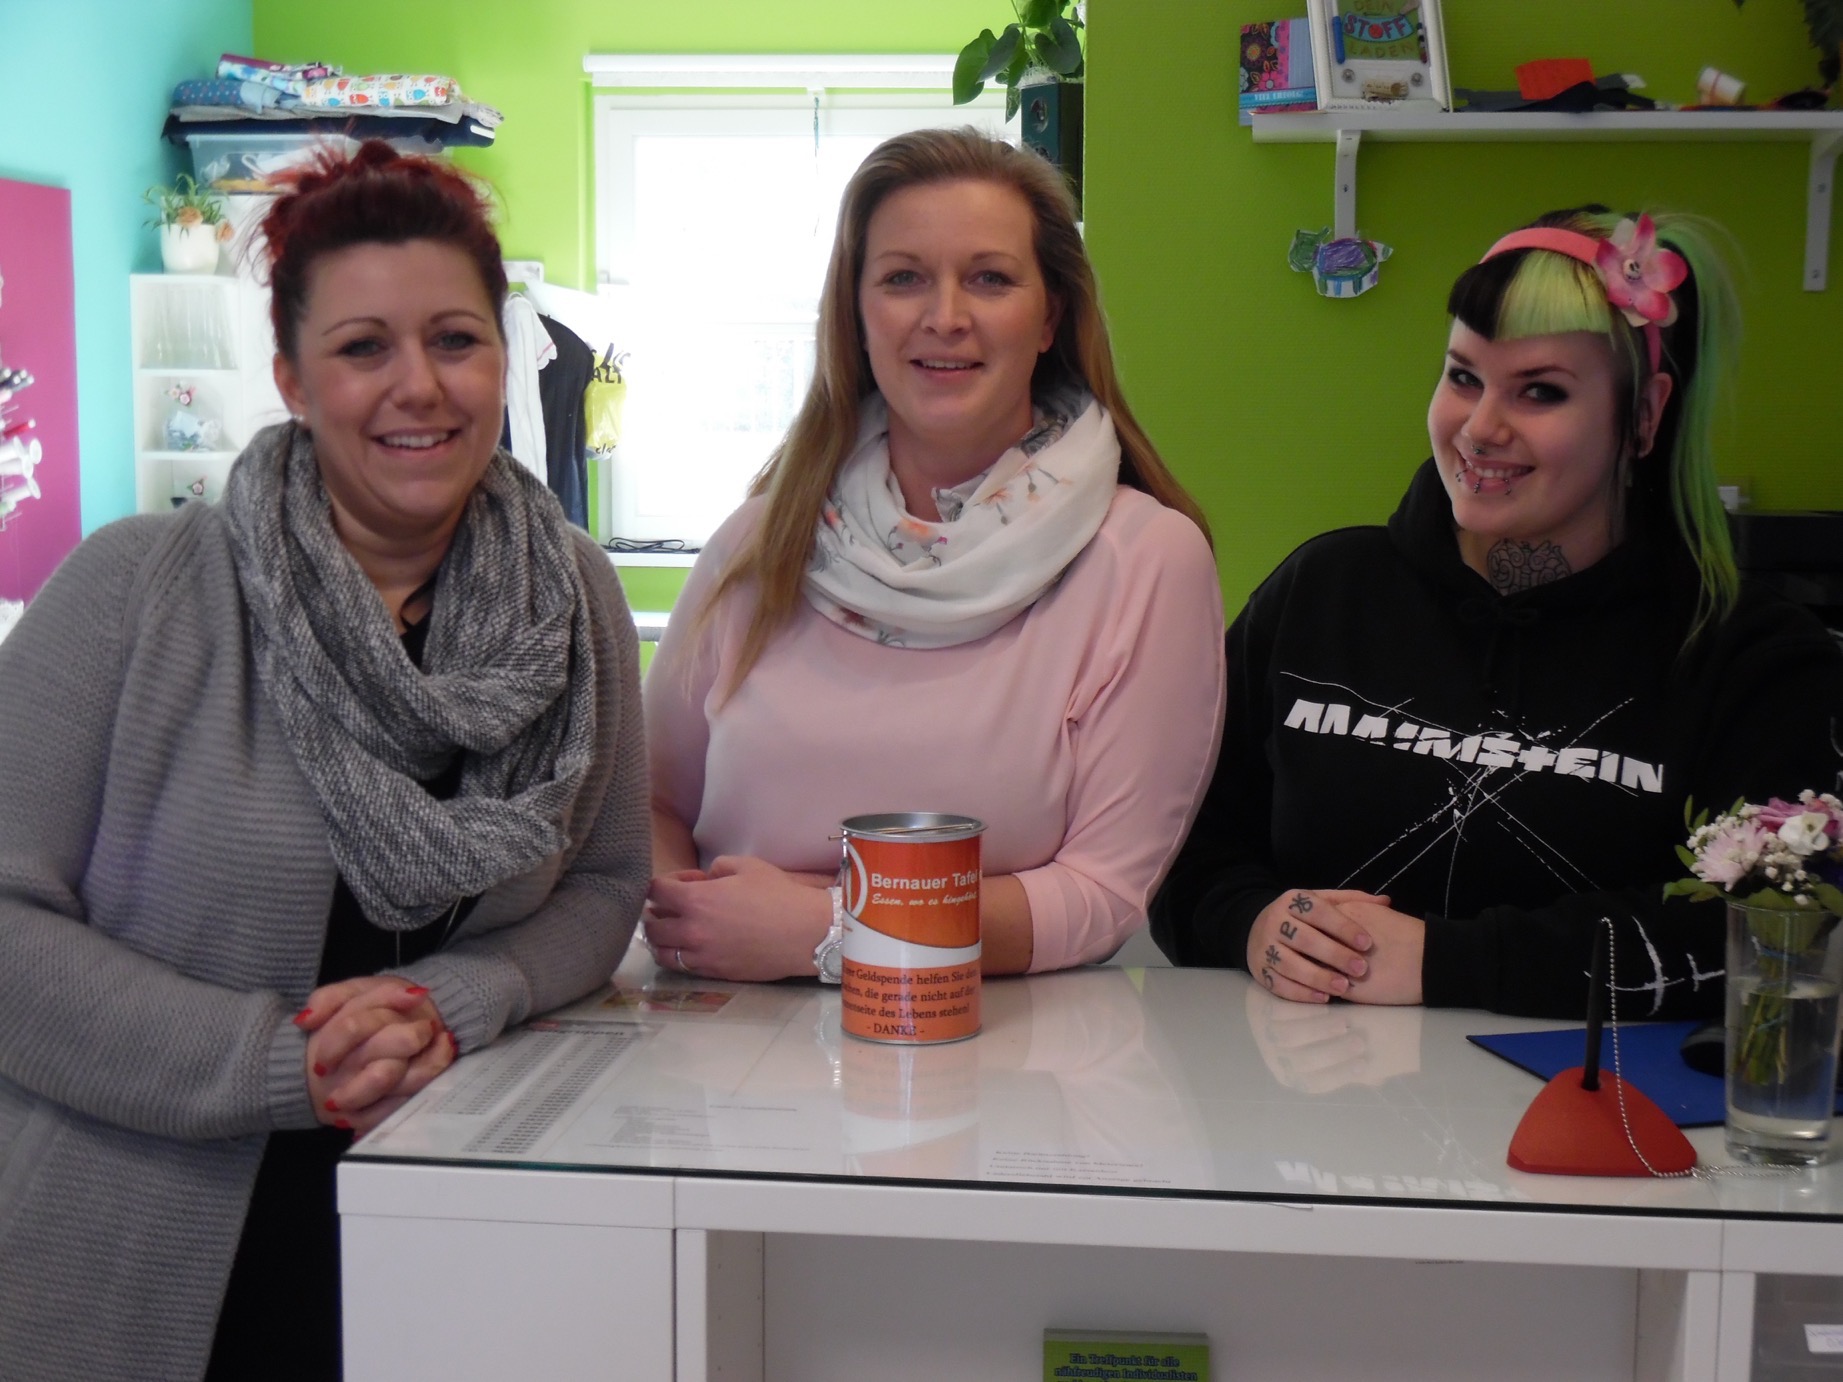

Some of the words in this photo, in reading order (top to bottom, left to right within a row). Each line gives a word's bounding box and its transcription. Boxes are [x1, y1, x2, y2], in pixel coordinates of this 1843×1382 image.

[1344, 14, 1406, 39] STOFF
[871, 873, 948, 890] Bernauer
[952, 868, 978, 887] Tafel
[871, 893, 904, 906] Essen,
[856, 968, 913, 985] Geldspende
[916, 973, 949, 985] helfen
[951, 971, 964, 982] Sie
[864, 987, 879, 1000] die
[881, 992, 917, 1003] gerade
[920, 990, 948, 1002] nicht
[949, 986, 964, 1000] auf
[878, 1006, 896, 1018] des
[898, 1007, 937, 1019] Lebens
[873, 1023, 917, 1036] DANKE
[1069, 1353, 1087, 1365] Ein
[1088, 1354, 1142, 1366] Treffpunkt
[1143, 1355, 1159, 1367] für
[1161, 1356, 1180, 1368] alle
[1054, 1366, 1121, 1380] nähfreudigen
[1122, 1368, 1198, 1381] Individualisten
